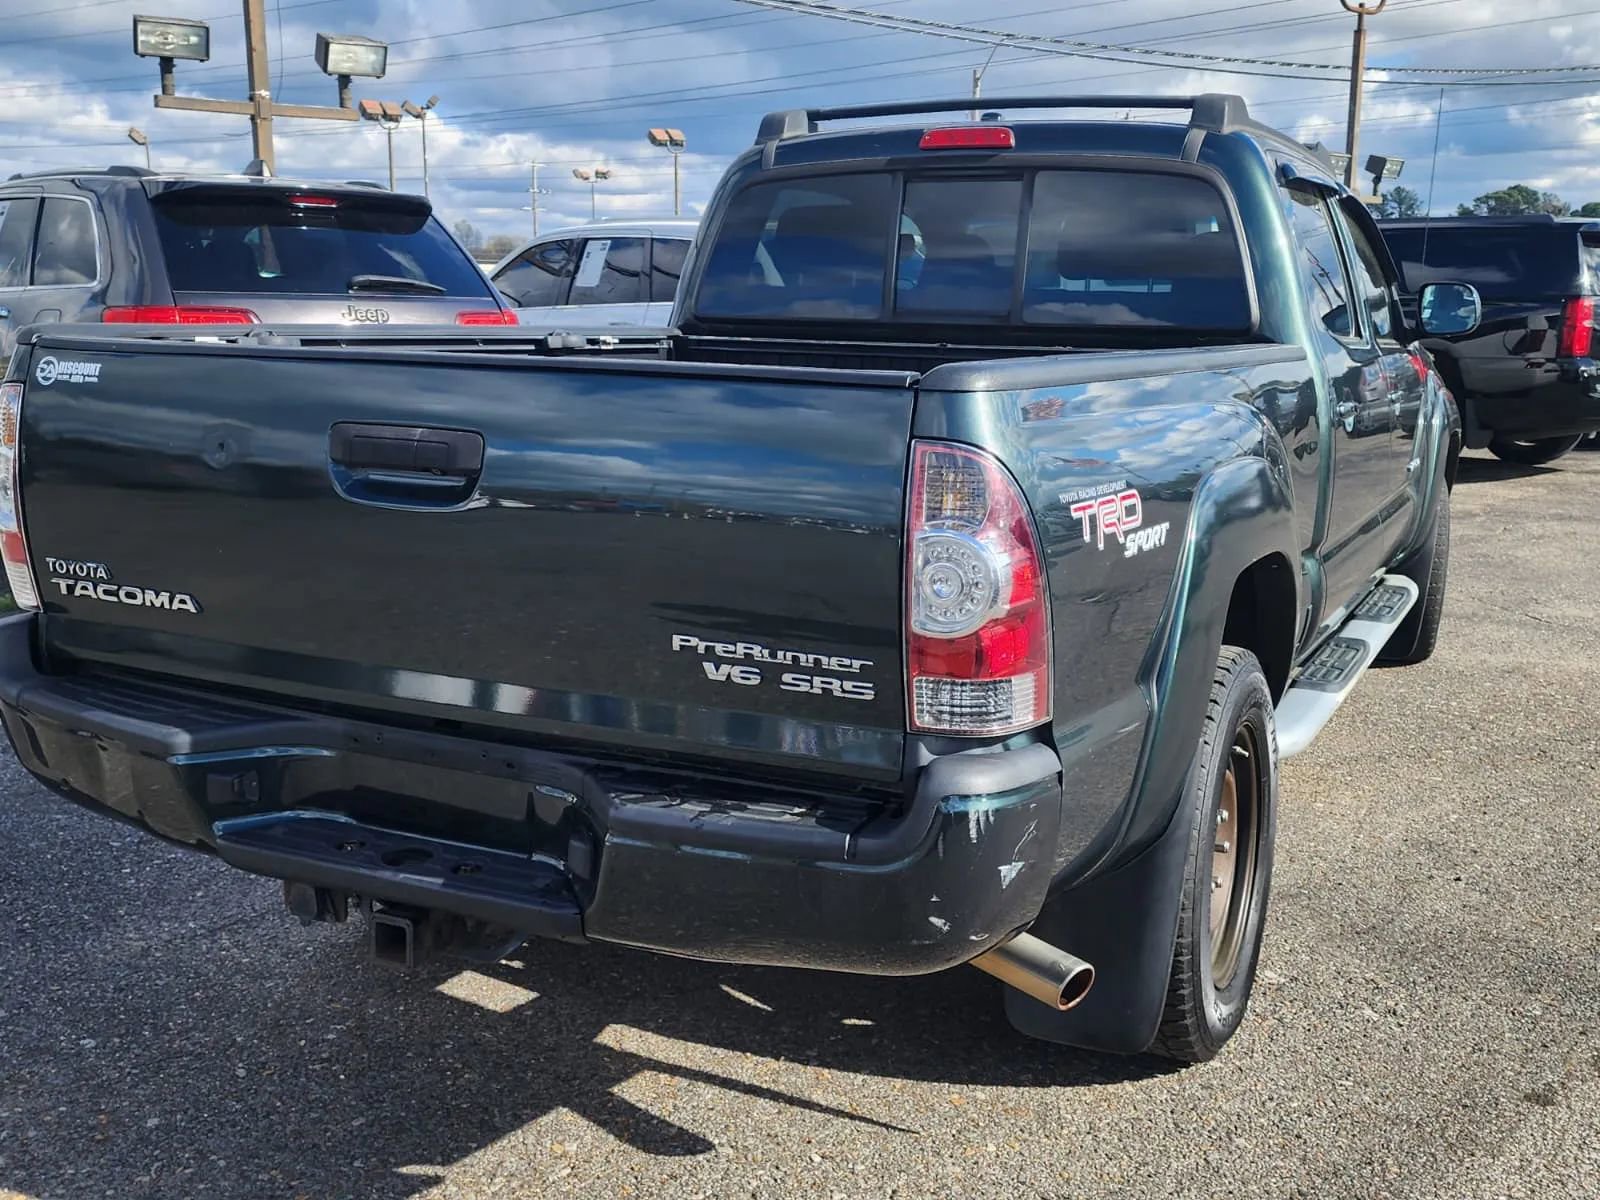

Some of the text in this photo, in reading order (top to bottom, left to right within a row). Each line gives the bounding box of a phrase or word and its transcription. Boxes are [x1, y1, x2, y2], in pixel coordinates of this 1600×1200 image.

[341, 303, 391, 323] Jeep
[58, 361, 102, 376] DISCOUNT
[1070, 488, 1142, 551] TRD
[1124, 521, 1170, 558] SPORT
[45, 557, 110, 580] TOYOTA
[50, 577, 200, 614] TACOMA
[671, 634, 874, 672] PreRunner
[702, 661, 876, 700] V6 SR5
